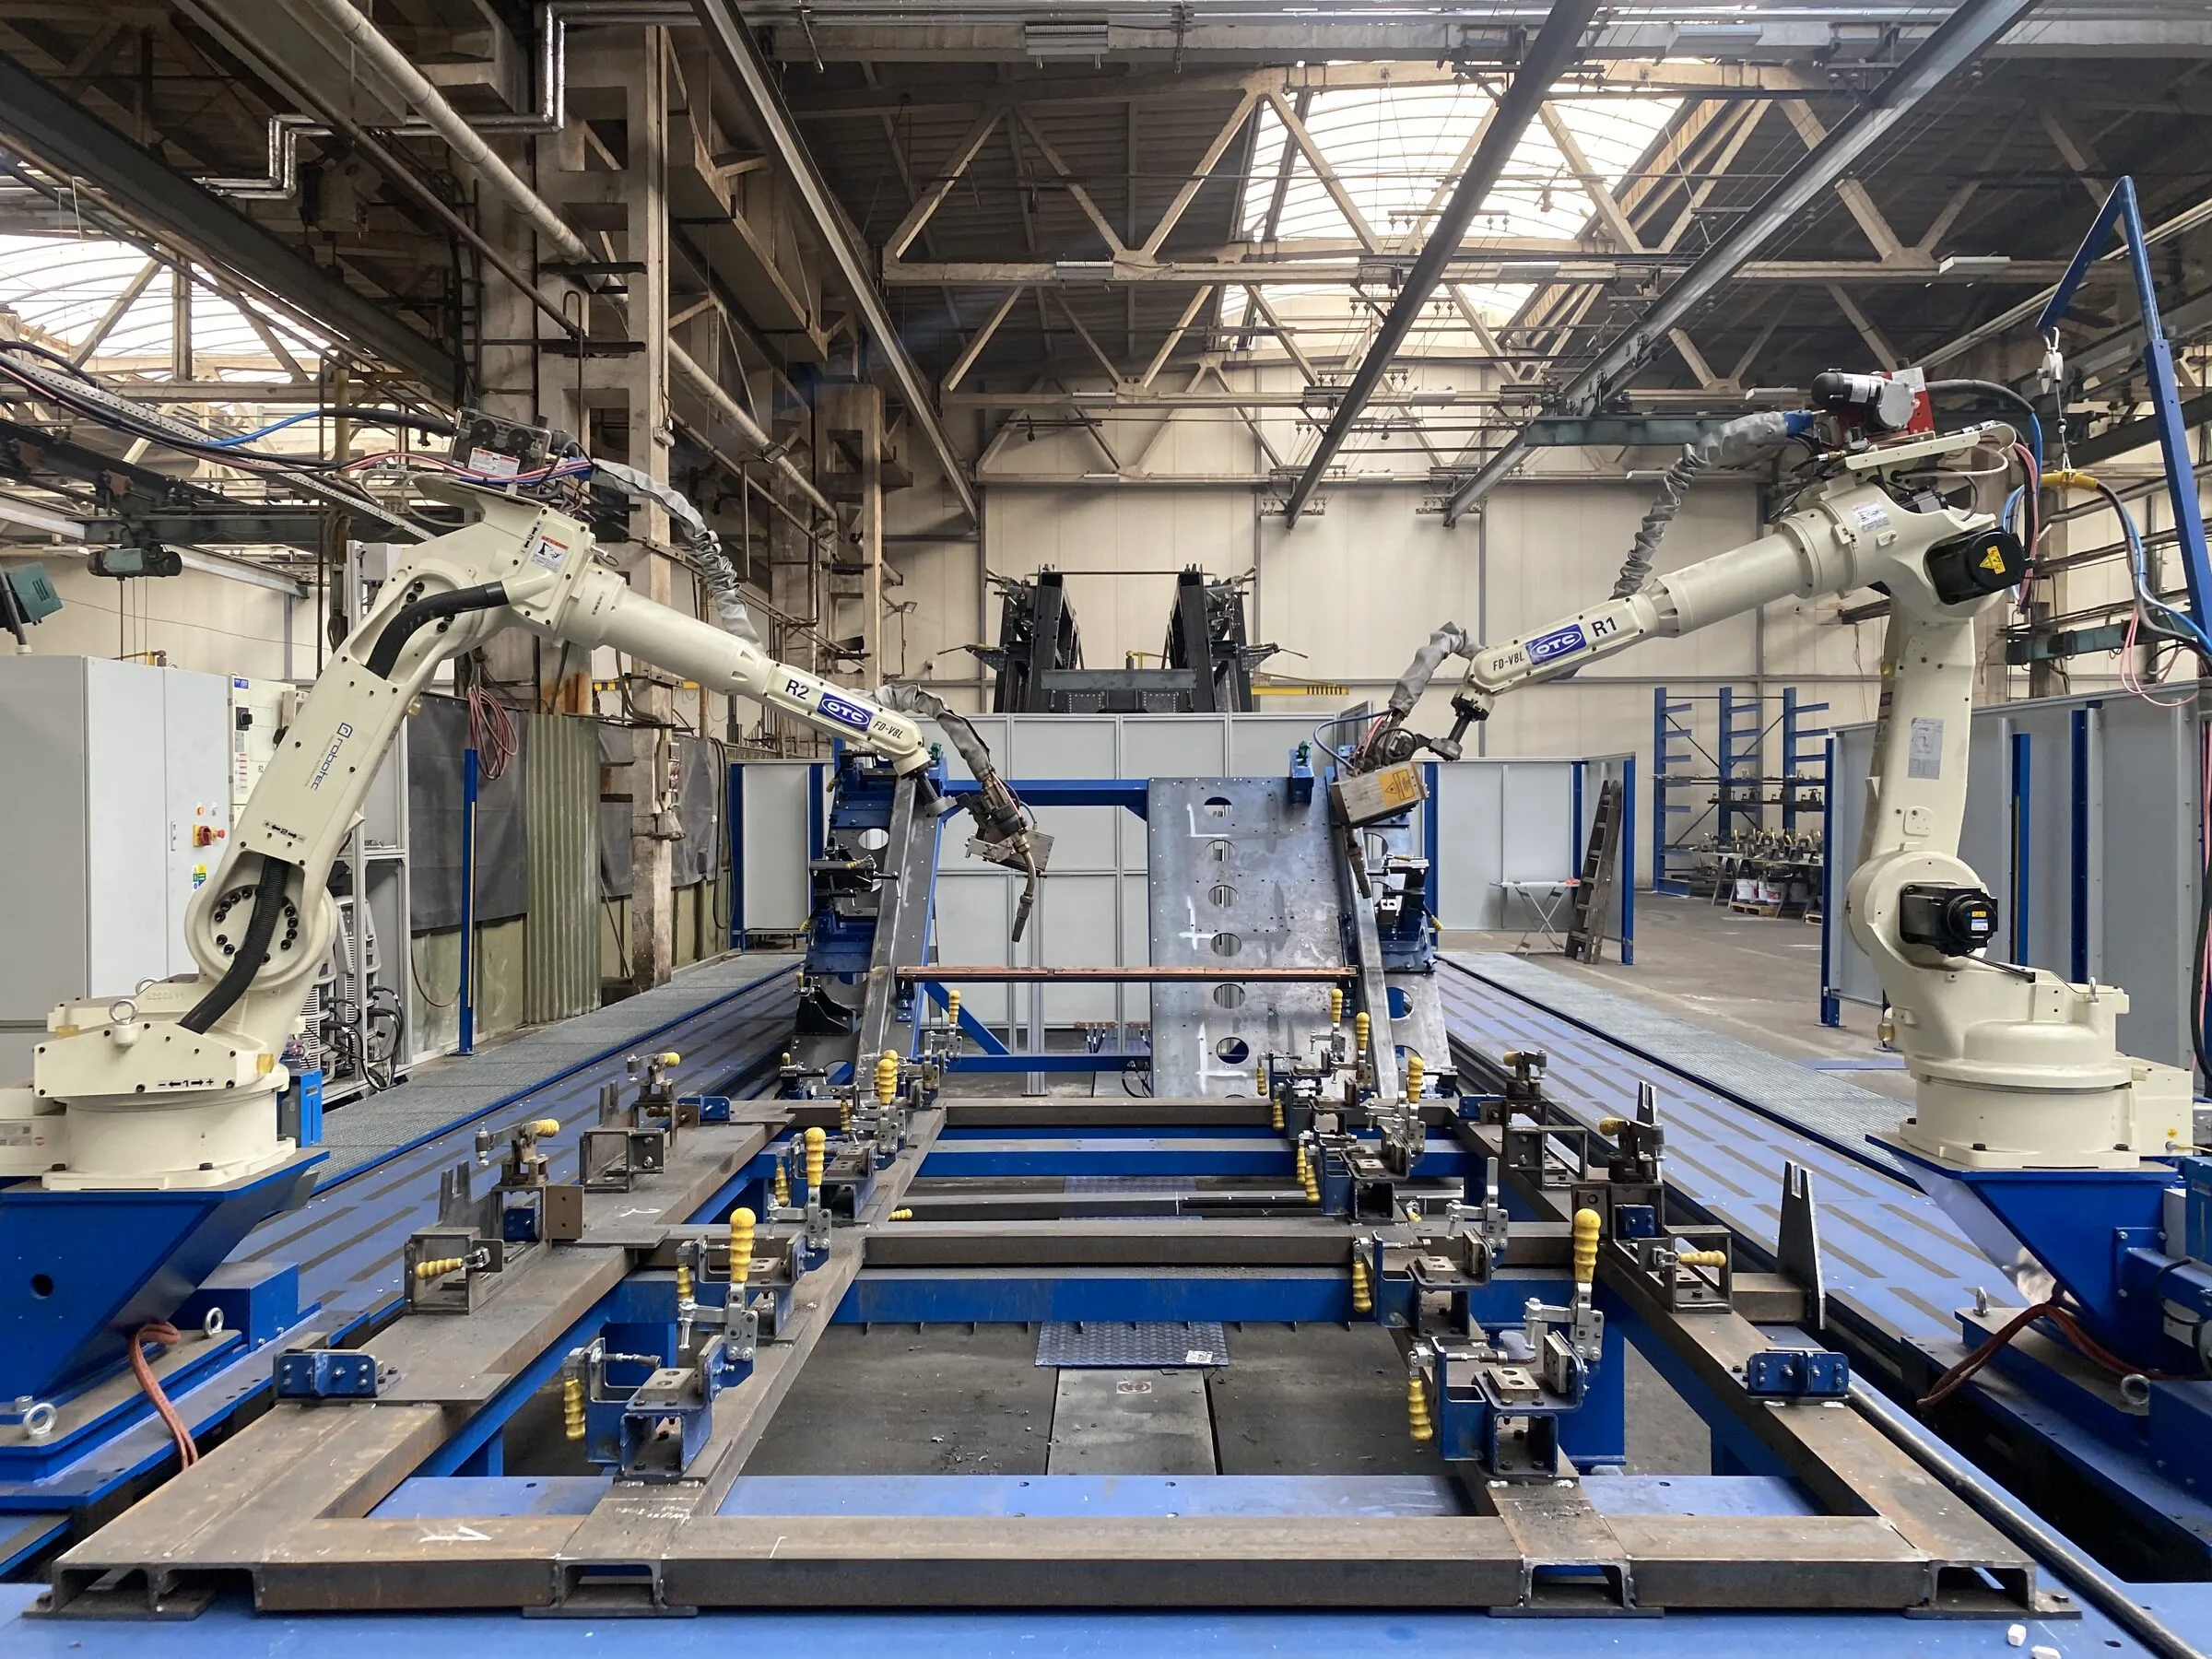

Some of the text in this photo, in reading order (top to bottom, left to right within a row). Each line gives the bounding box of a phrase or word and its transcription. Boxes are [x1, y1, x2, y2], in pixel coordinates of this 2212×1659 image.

[1592, 617, 1618, 637] R1
[1493, 634, 1575, 671] FD-V8L OTC
[785, 678, 810, 700] R2
[827, 701, 903, 739] OTC FD-V8L
[311, 737, 343, 791] robotec
